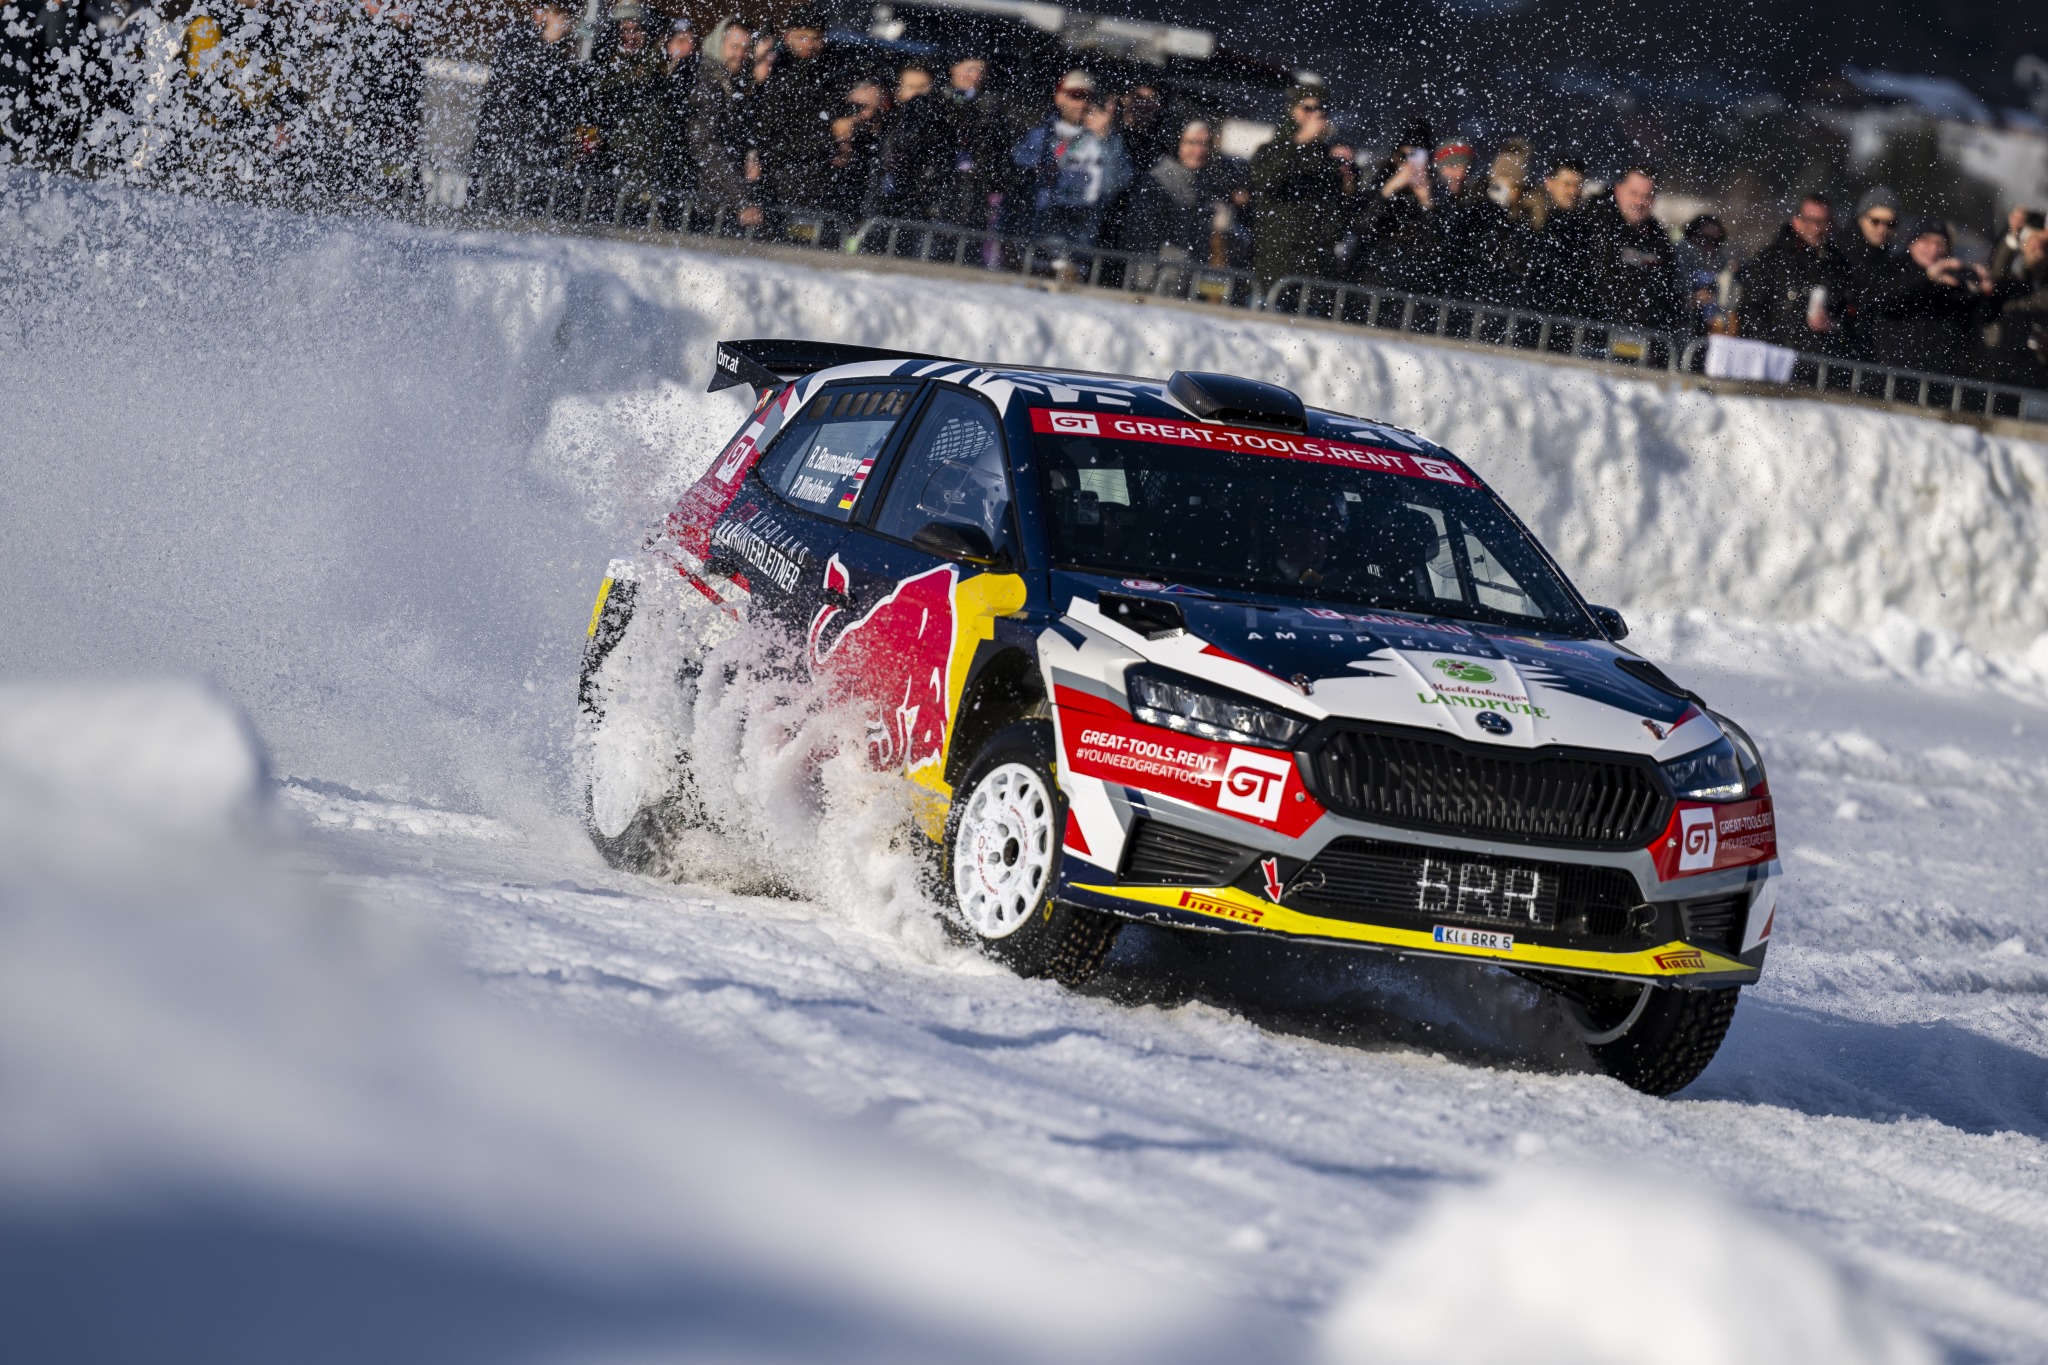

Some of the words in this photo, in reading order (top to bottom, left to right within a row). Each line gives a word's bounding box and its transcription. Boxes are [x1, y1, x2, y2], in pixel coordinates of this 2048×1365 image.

[717, 346, 739, 374] brr.at
[1054, 415, 1095, 431] GT
[1114, 419, 1405, 470] GREAT-TOOLS.RENT
[1417, 461, 1453, 478] GT
[1247, 631, 1297, 640] AM
[1328, 633, 1546, 667] SPIELBERG
[1417, 692, 1550, 719] LANDPUTE
[1080, 729, 1218, 771] GREAT-TOOLS.RENT
[1076, 747, 1213, 789] #YOUNEEDGREATTOOLS
[1227, 765, 1284, 803] GT
[1685, 821, 1714, 856] GT
[1178, 890, 1264, 923] PIRELLI
[1446, 929, 1459, 943] KI
[1471, 932, 1497, 948] BRR
[1502, 936, 1511, 949] 5
[1653, 950, 1706, 970] PIRELLI
